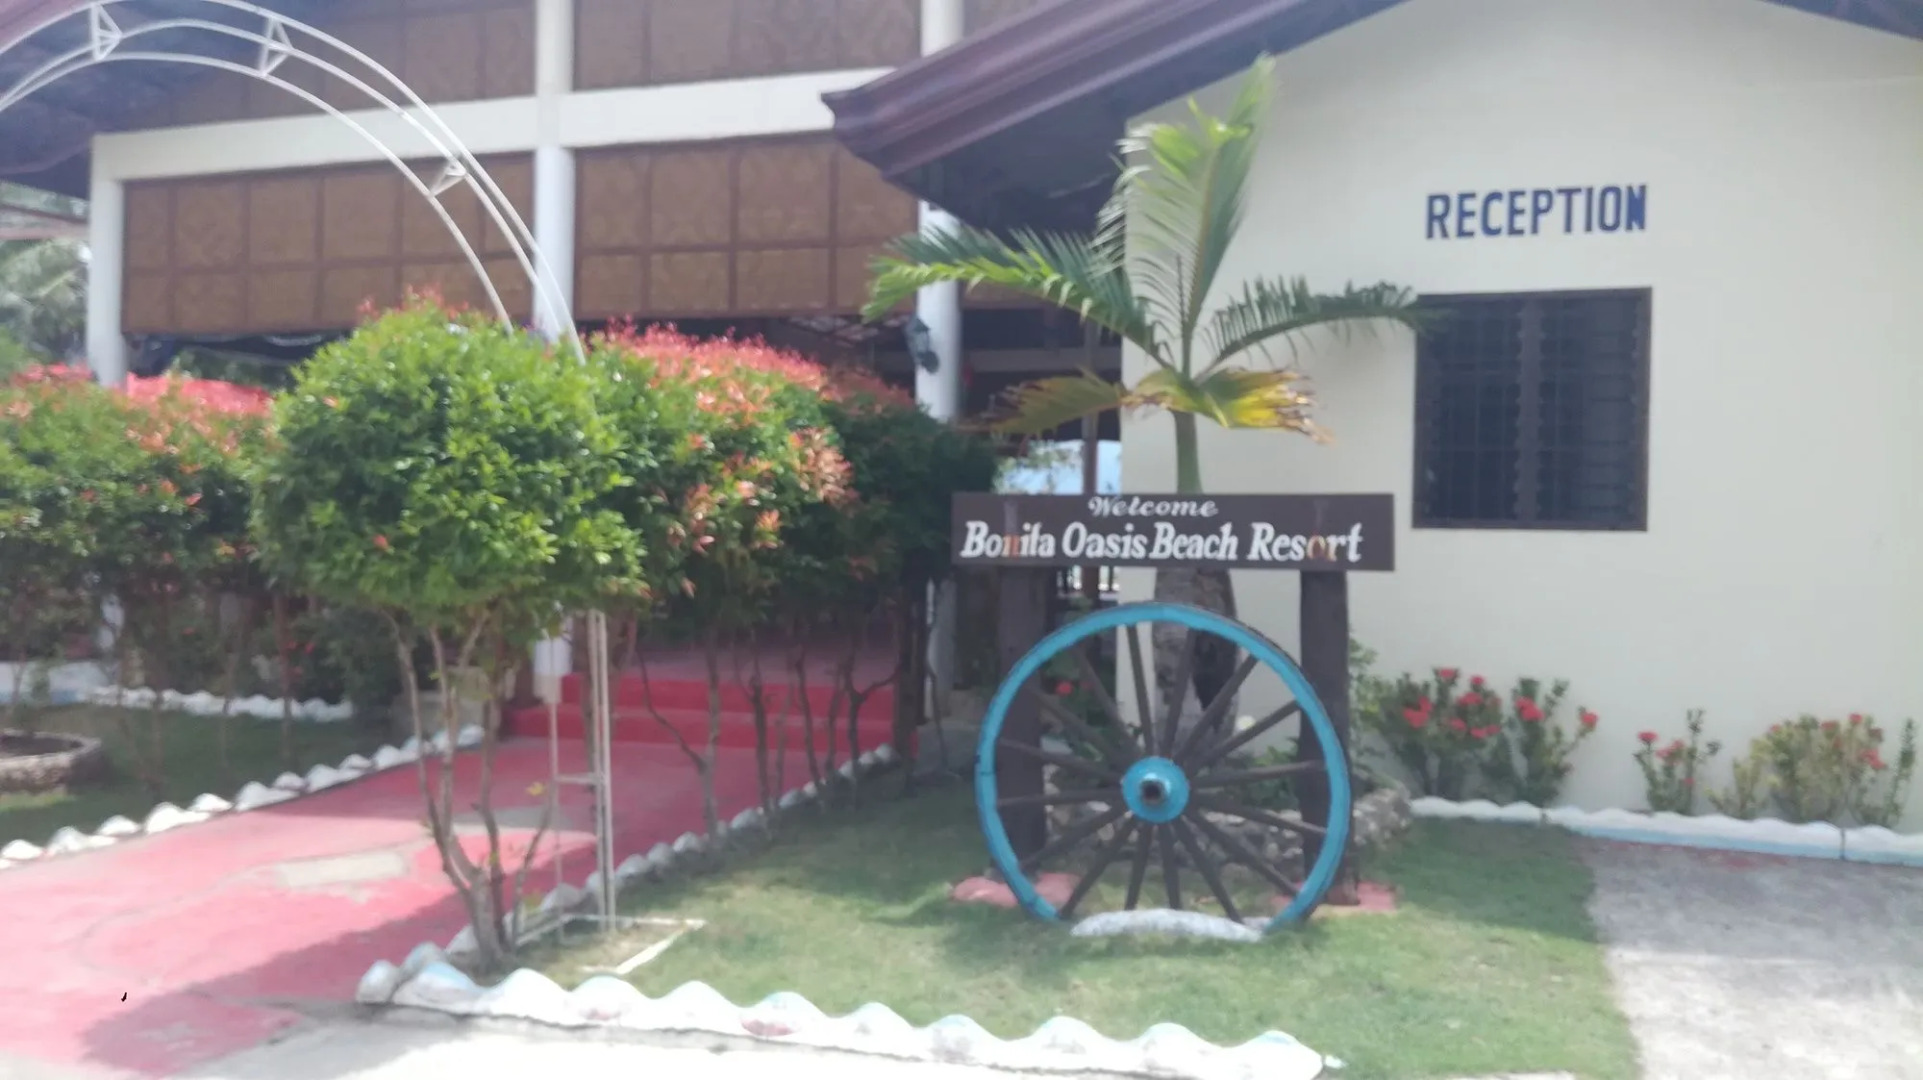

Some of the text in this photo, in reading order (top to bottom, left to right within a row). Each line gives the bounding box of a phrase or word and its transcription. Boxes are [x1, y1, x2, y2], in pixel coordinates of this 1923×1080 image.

[1426, 185, 1647, 239] RECEPTION
[1088, 496, 1218, 518] Welcome
[960, 520, 1363, 562] Bonita Oasis Beach Resort
